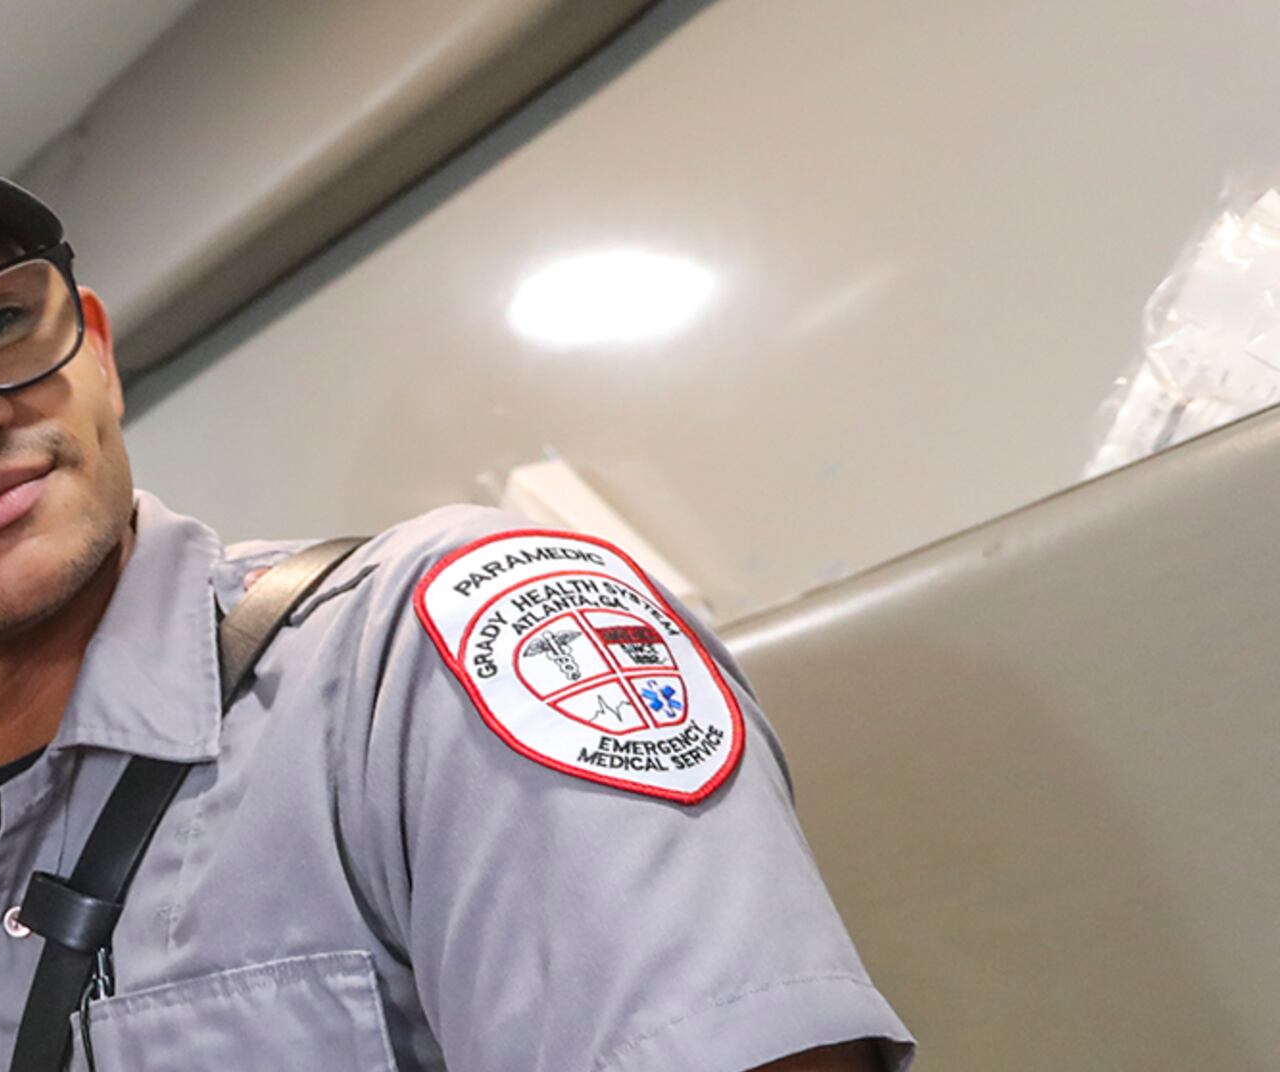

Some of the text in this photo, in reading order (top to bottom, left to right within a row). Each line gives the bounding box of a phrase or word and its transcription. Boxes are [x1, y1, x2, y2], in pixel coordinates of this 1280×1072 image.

[453, 547, 606, 597] PARAMEDIC
[474, 579, 679, 679] GRADY HEALTH SYSTEM
[577, 724, 724, 772] MEDICAL SERVICE
[598, 719, 704, 756] EMERGENCY
